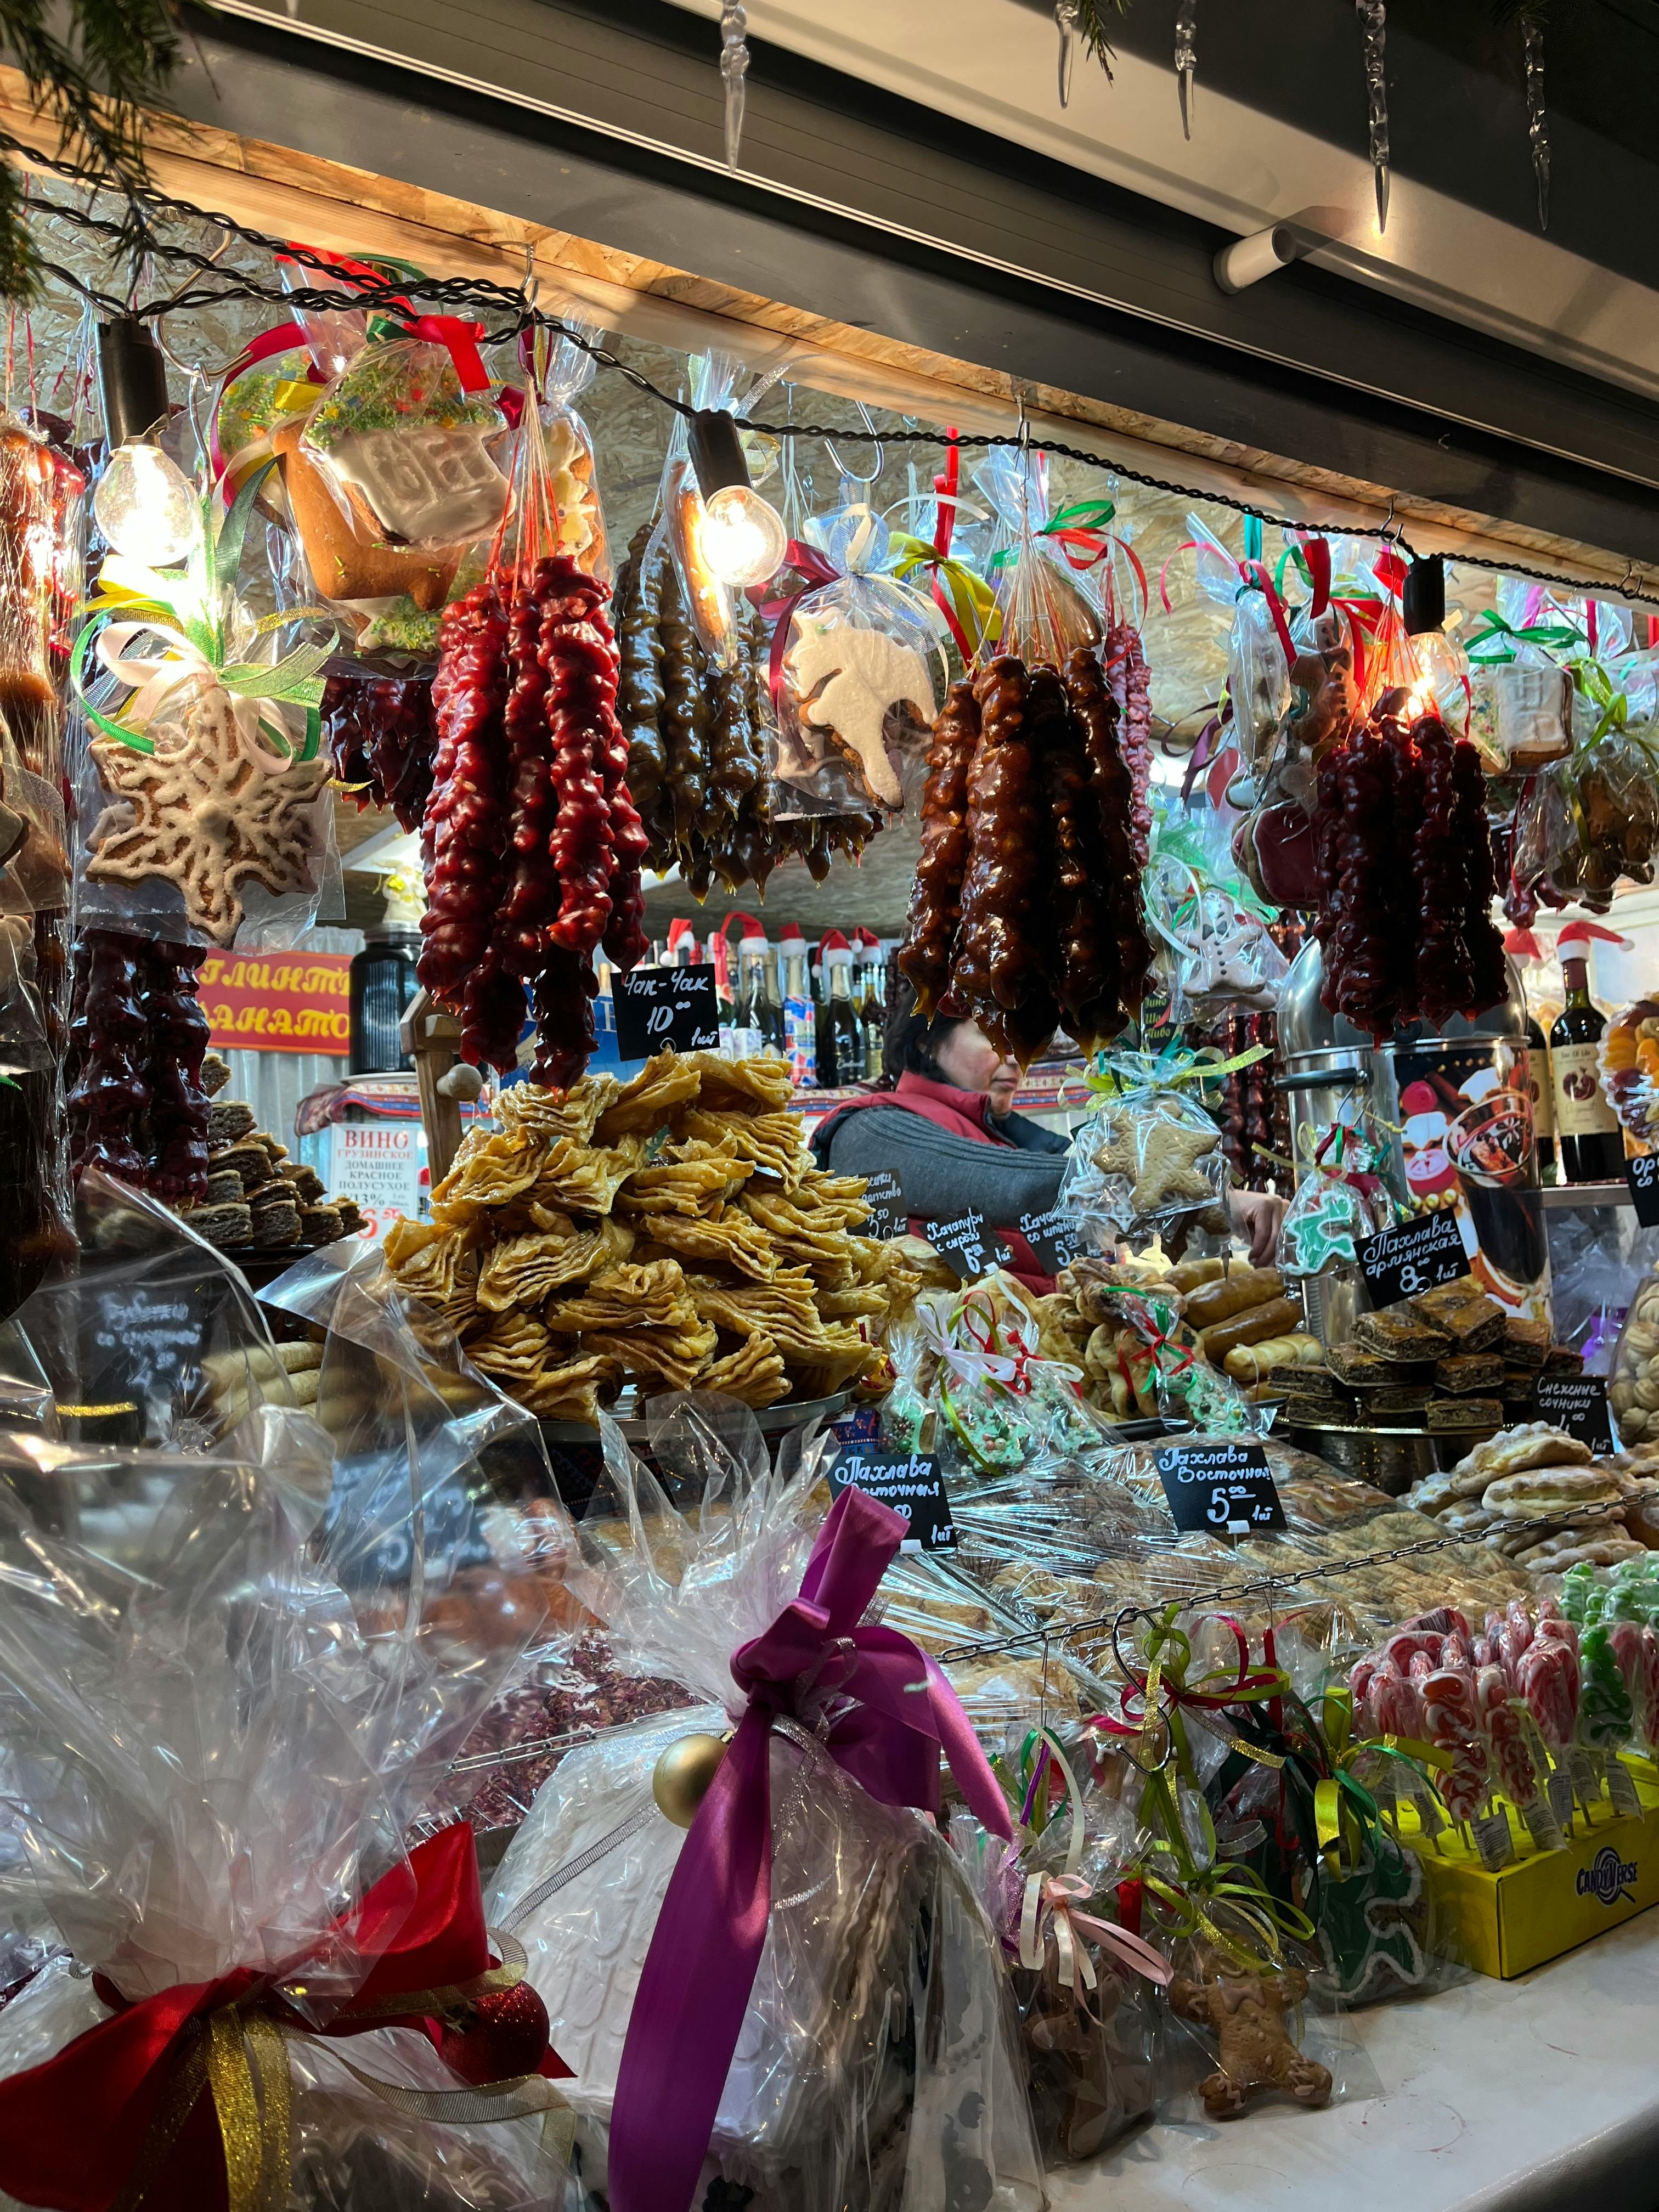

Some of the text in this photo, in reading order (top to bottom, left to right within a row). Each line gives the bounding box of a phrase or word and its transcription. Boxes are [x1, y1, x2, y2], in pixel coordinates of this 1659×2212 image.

[345, 1130, 409, 1150] ВИНО
[337, 1150, 413, 1160] ГРУЗИНСКОЕ
[345, 1160, 404, 1171] ДОМАШНЕЕ
[1633, 1156, 1659, 1178] Ор
[338, 1181, 410, 1191] ПОЛУСУХОЕ
[349, 1171, 402, 1180] КРАСНОЕ
[927, 1207, 984, 1241] Хачапури
[1363, 1214, 1457, 1263] Пахлава
[1054, 1240, 1070, 1267] 5
[1365, 1233, 1463, 1279] армянская
[1400, 1265, 1420, 1293] 8
[834, 1454, 932, 1485] Пахлава
[1158, 1444, 1249, 1472] Пахлава
[1177, 1465, 1271, 1483] Восточная
[850, 1481, 940, 1498] осточная
[1206, 1487, 1230, 1523] 5
